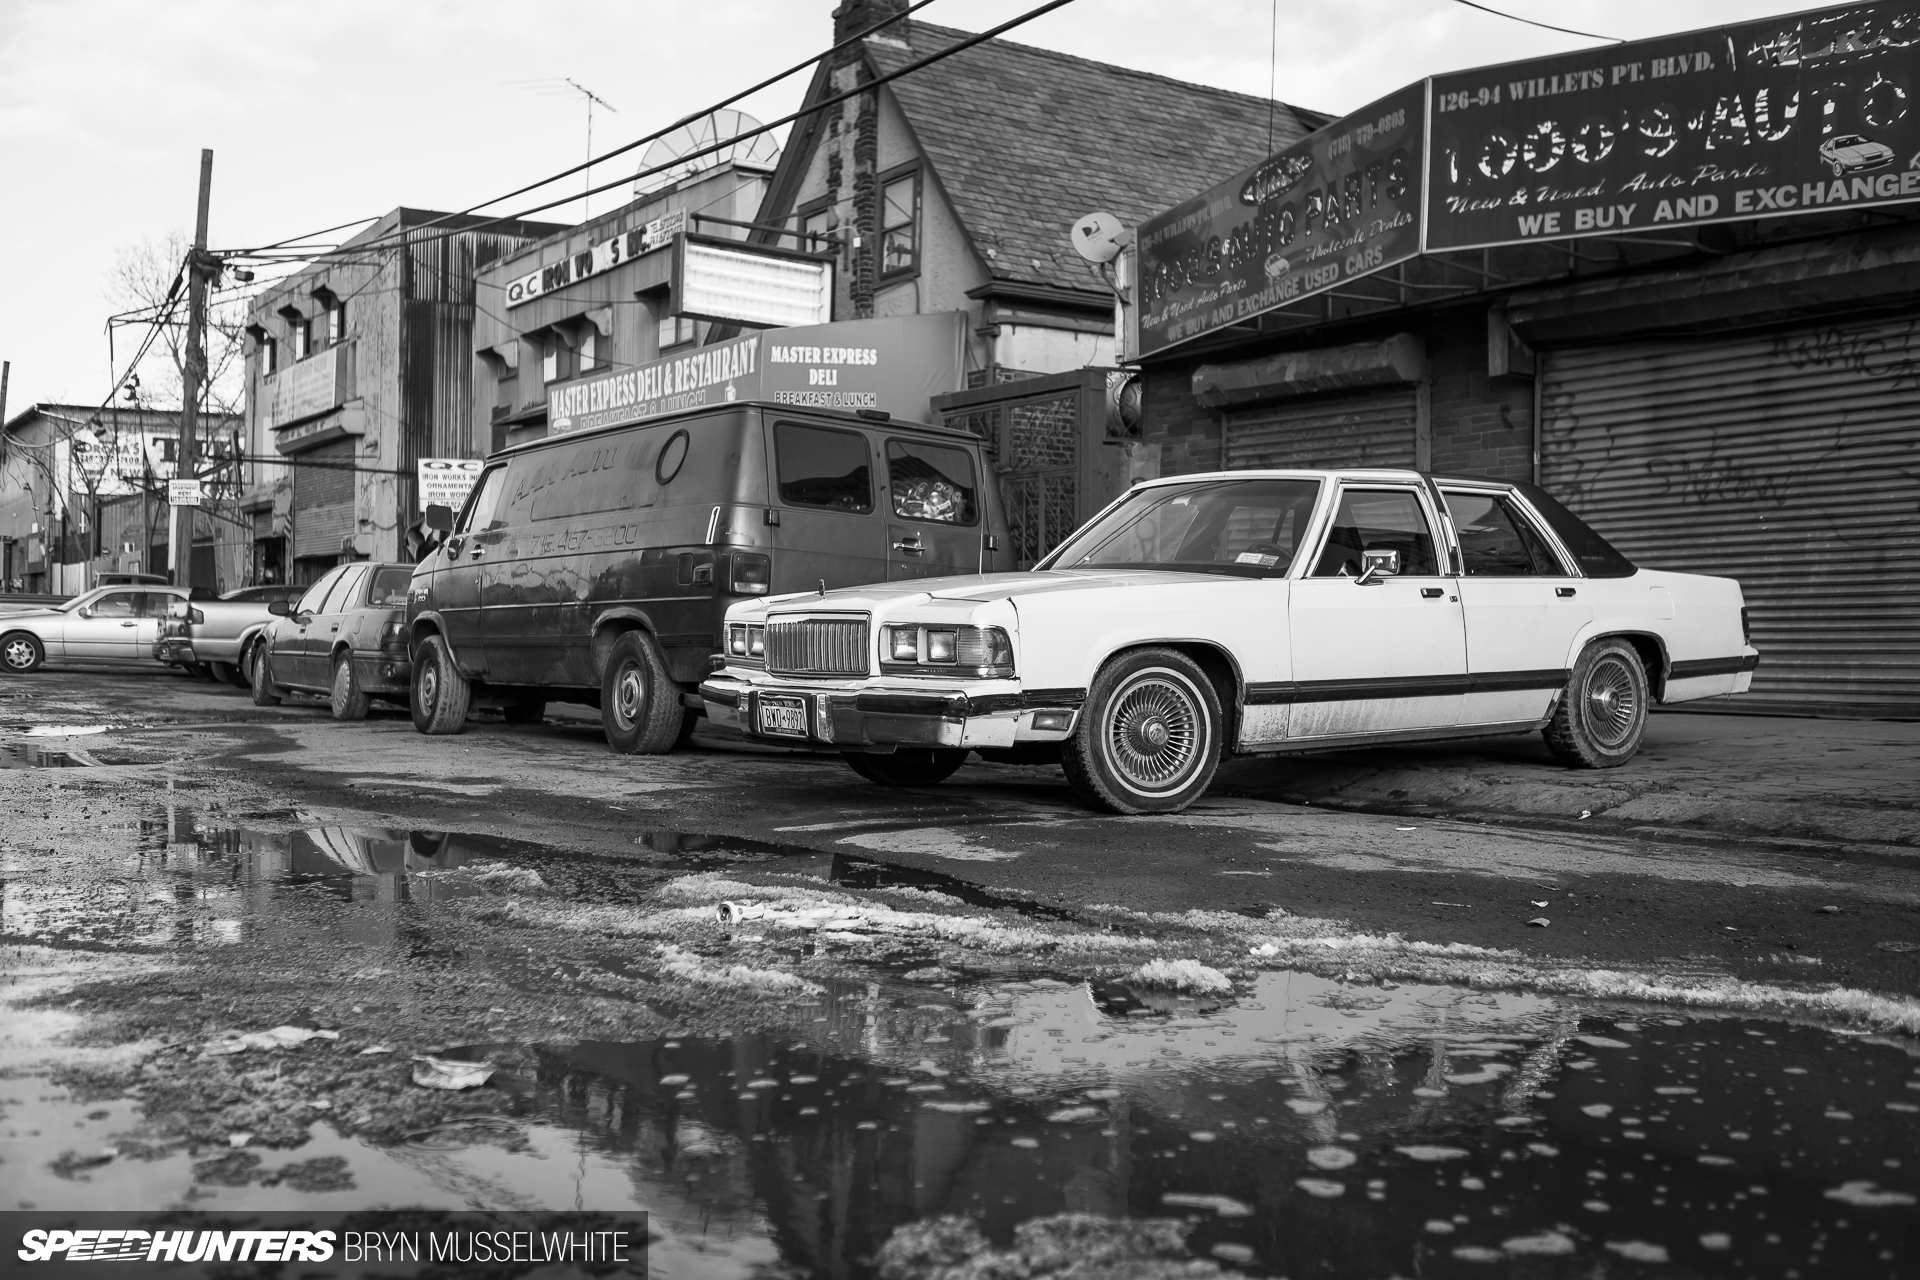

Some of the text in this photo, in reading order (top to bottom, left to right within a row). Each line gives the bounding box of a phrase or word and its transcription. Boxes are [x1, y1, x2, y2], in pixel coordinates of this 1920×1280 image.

[1439, 51, 1715, 112] 126-94 WILLETS PT. BLVD.
[1705, 70, 1911, 151] AUTO
[1328, 134, 1351, 160] (718)
[1306, 148, 1409, 237] PARTS
[1446, 163, 1772, 214] New & Used Auto Parts
[1517, 171, 1920, 236] WE BUY AND EXCHANGE
[1369, 211, 1413, 238] Dealer
[541, 258, 571, 292] IRON
[1167, 244, 1383, 342] WE BUY AND EXCHANGE USED CARS
[1142, 279, 1247, 329] New & Used Auto Parts
[551, 337, 758, 420] MASTER EXPRESS DELI & RESTAURANT
[771, 345, 877, 366] MASTER EXPRESS
[809, 368, 837, 386] DELI
[774, 391, 877, 408] BREAKFAST & LUNCH
[111, 468, 141, 478] NEW
